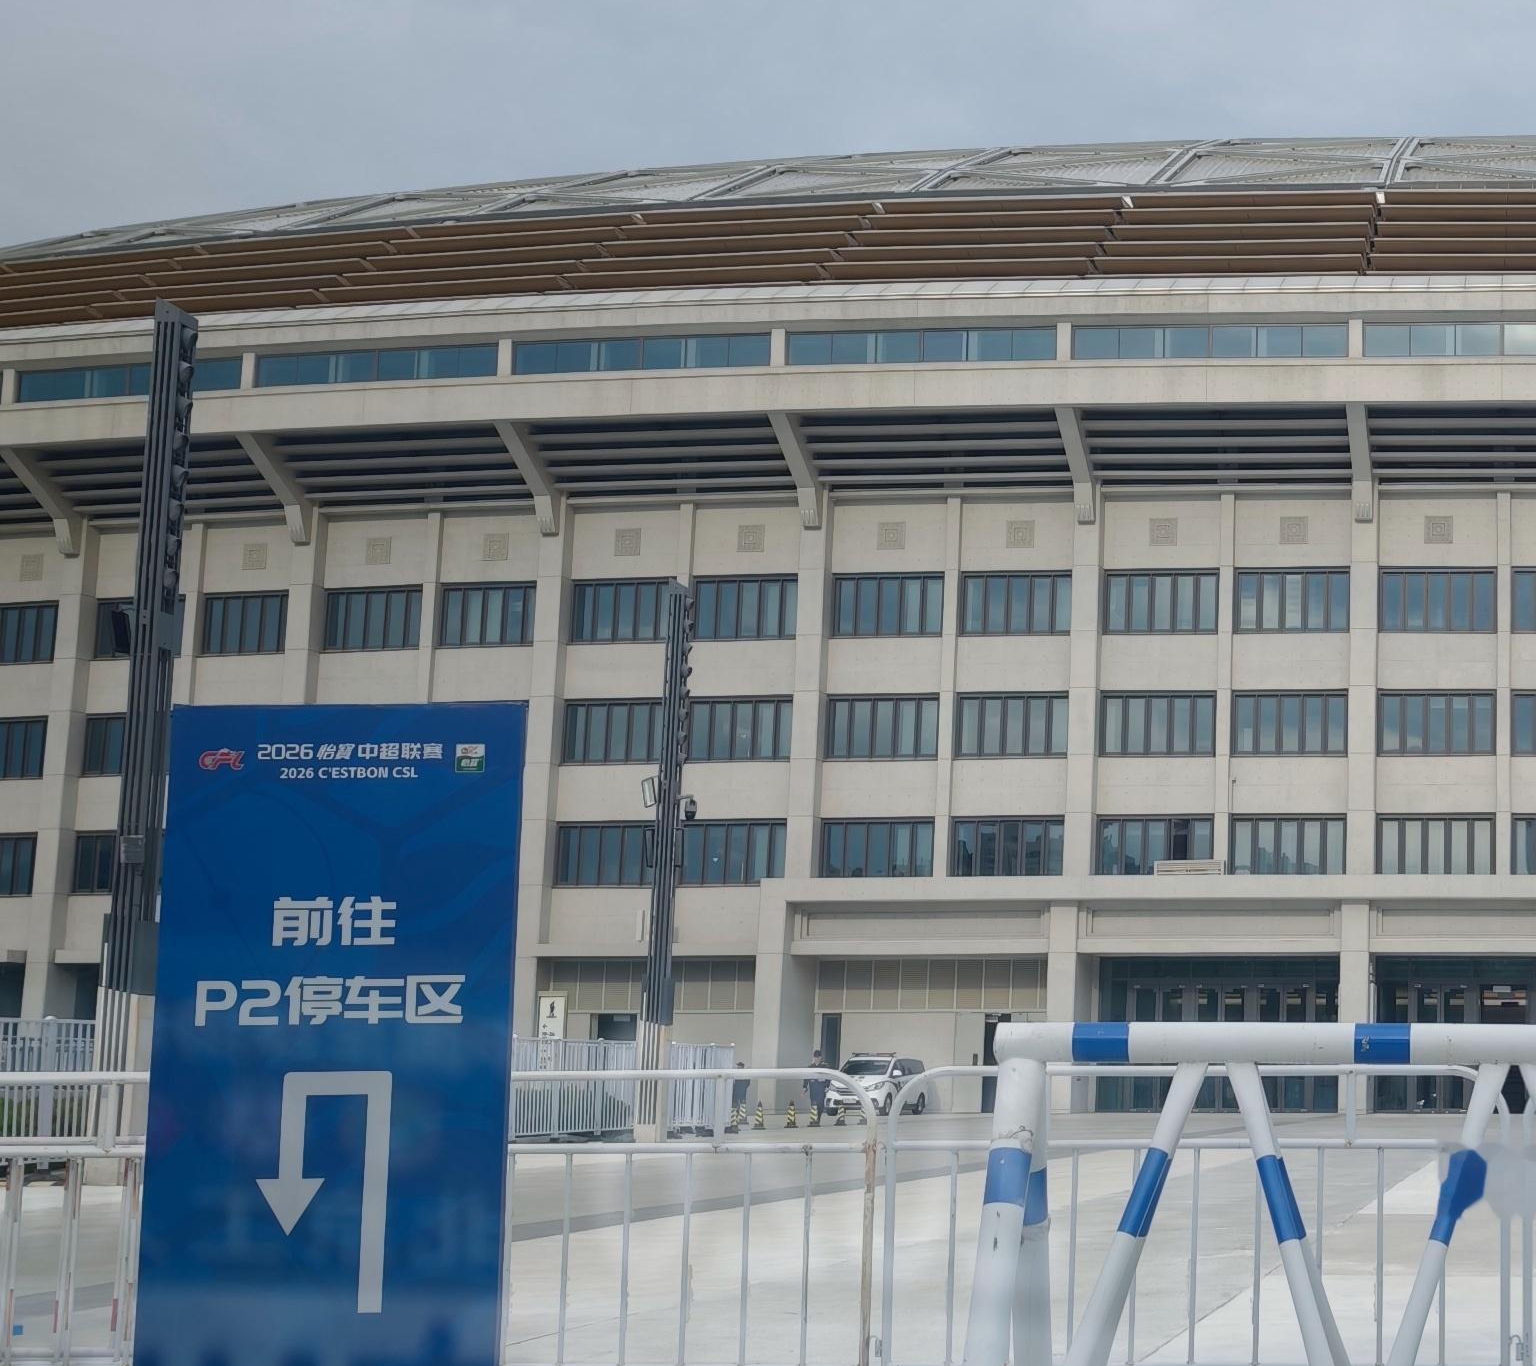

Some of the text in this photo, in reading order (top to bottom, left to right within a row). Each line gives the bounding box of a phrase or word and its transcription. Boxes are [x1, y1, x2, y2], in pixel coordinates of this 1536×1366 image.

[257, 743, 314, 760] 2026
[358, 742, 443, 760] 中超联赛
[280, 766, 419, 779] 2026 C'ESTBON CSL
[272, 895, 397, 947] 前往
[194, 974, 466, 1027] P2停车区
